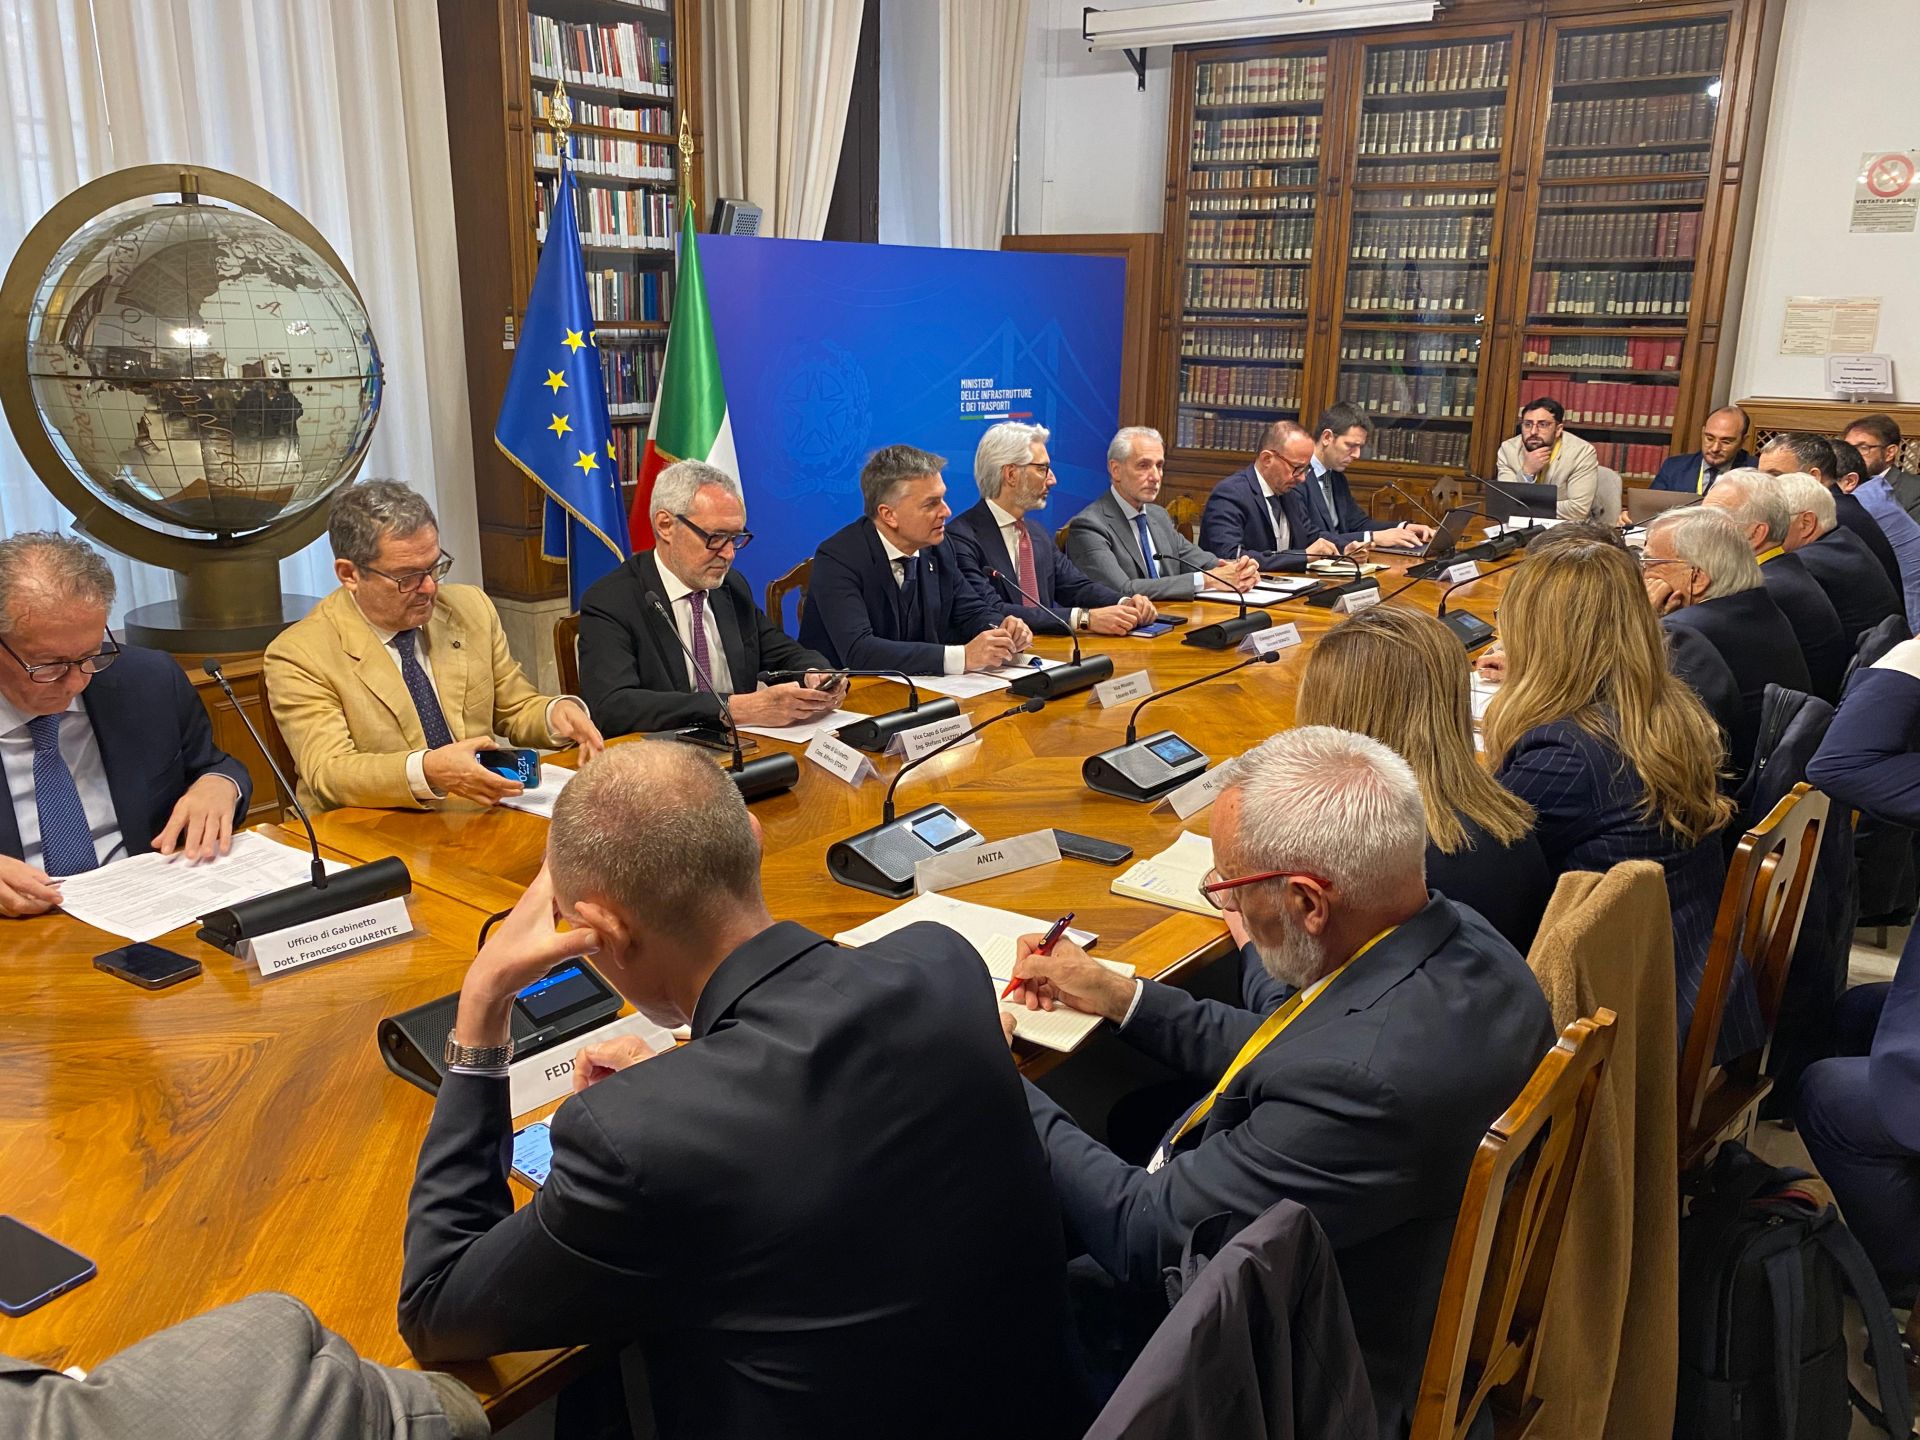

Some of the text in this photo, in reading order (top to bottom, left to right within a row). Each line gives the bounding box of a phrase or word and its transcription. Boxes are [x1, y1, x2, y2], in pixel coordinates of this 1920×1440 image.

[960, 379, 994, 389] MINISTERO
[960, 388, 1032, 401] DELLE INFRASTRUTTURE
[960, 401, 1010, 412] E DEI TRASPORTI
[912, 733, 924, 741] Vice
[923, 731, 935, 739] Capo
[940, 724, 961, 734] Gabinetto
[925, 739, 942, 748] Stefano
[822, 741, 832, 750] Capo
[834, 748, 849, 761] Gabinetto
[517, 756, 528, 782] 12:20
[1202, 780, 1213, 791] FAI
[977, 851, 1004, 865] ANITA
[287, 917, 377, 949] Ufficio di Gabinetto
[273, 925, 398, 969] Dott. Francesco GUARENTE
